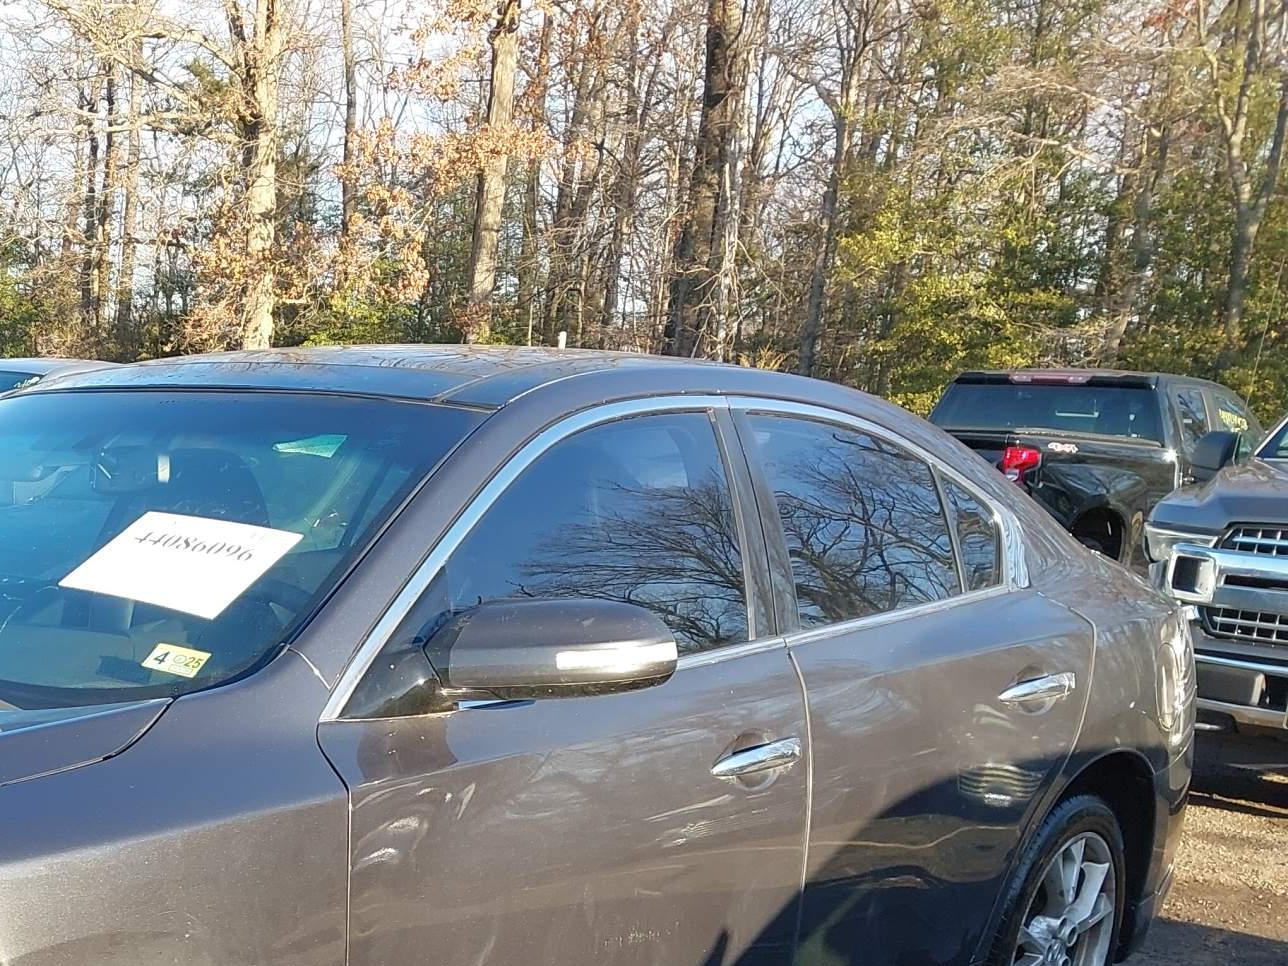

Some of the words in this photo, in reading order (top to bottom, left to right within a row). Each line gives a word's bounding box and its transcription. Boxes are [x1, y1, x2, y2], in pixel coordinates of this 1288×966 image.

[134, 531, 255, 561] 44086096
[153, 650, 171, 665] 4
[183, 656, 205, 669] 25
